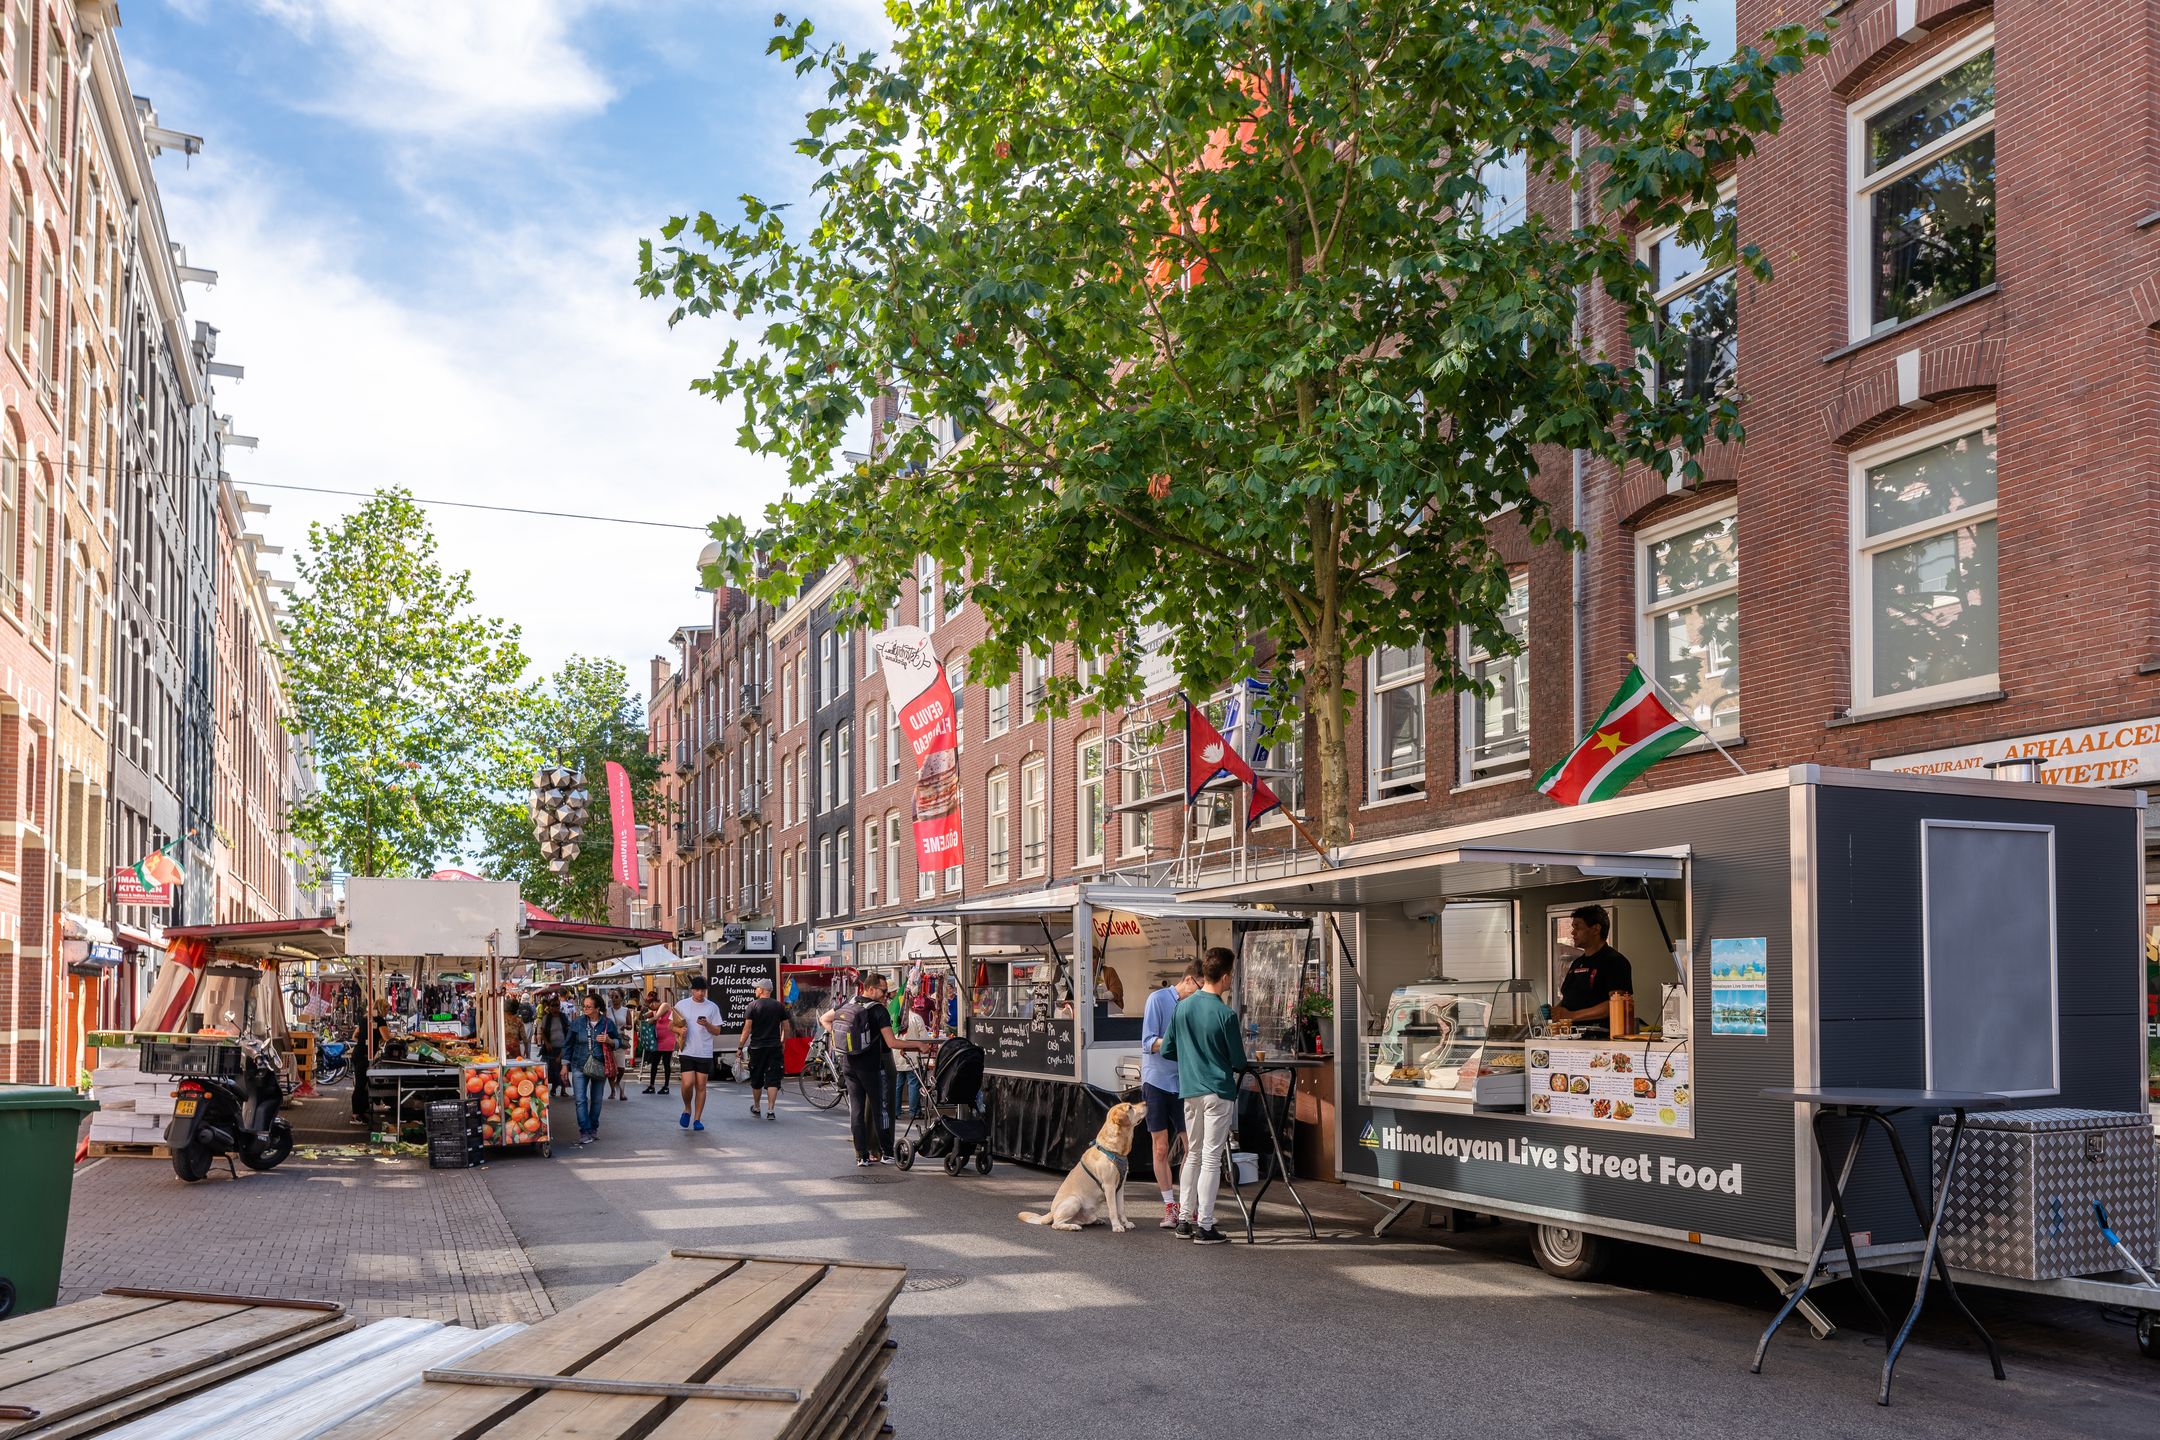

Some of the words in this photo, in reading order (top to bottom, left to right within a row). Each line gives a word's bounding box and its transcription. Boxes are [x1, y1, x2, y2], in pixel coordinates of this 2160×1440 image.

[2041, 758, 2140, 785] WIETIE
[118, 885, 163, 893] KITCEN
[716, 964, 736, 974] Deli
[740, 964, 767, 974] Fresh
[711, 975, 772, 986] Delicatess
[729, 995, 755, 1004] Olijven
[1382, 1125, 1503, 1163] Himalayan
[1508, 1136, 1557, 1170] Live
[1563, 1144, 1652, 1183] Street
[1659, 1156, 1743, 1195] Food
